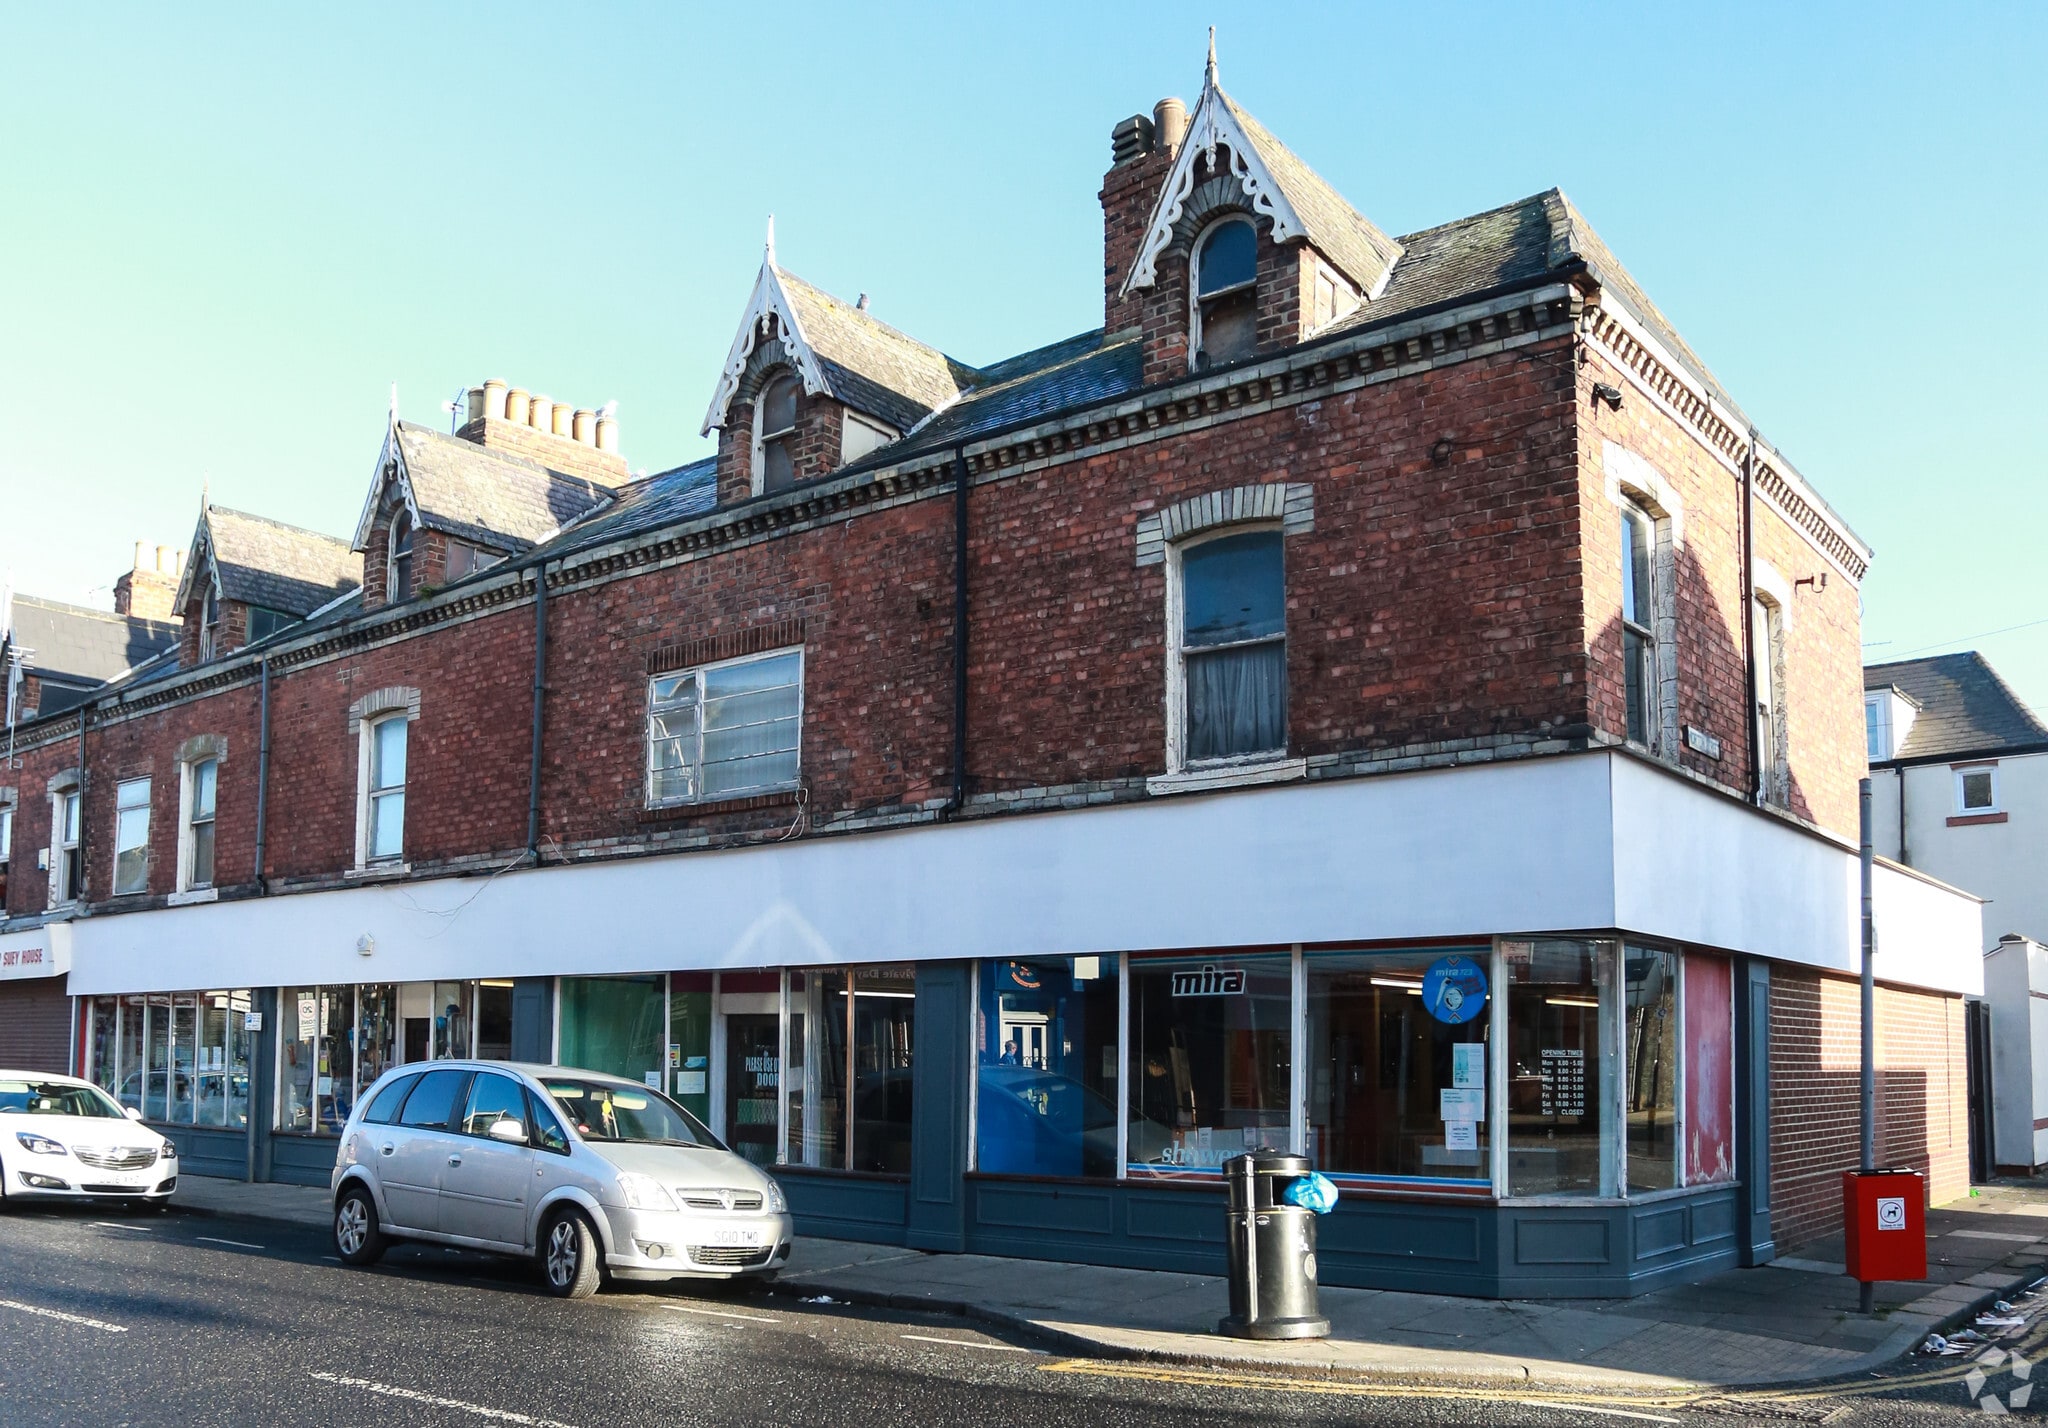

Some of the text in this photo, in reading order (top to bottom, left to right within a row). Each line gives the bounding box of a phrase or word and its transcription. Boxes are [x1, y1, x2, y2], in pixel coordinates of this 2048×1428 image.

[3, 948, 43, 967] SUEY HOUSE
[1435, 968, 1459, 977] mira
[1172, 964, 1247, 997] mira
[1541, 1049, 1584, 1057] OPENING TIMES
[745, 1056, 763, 1072] PLEASE
[714, 1230, 738, 1244] SG10
